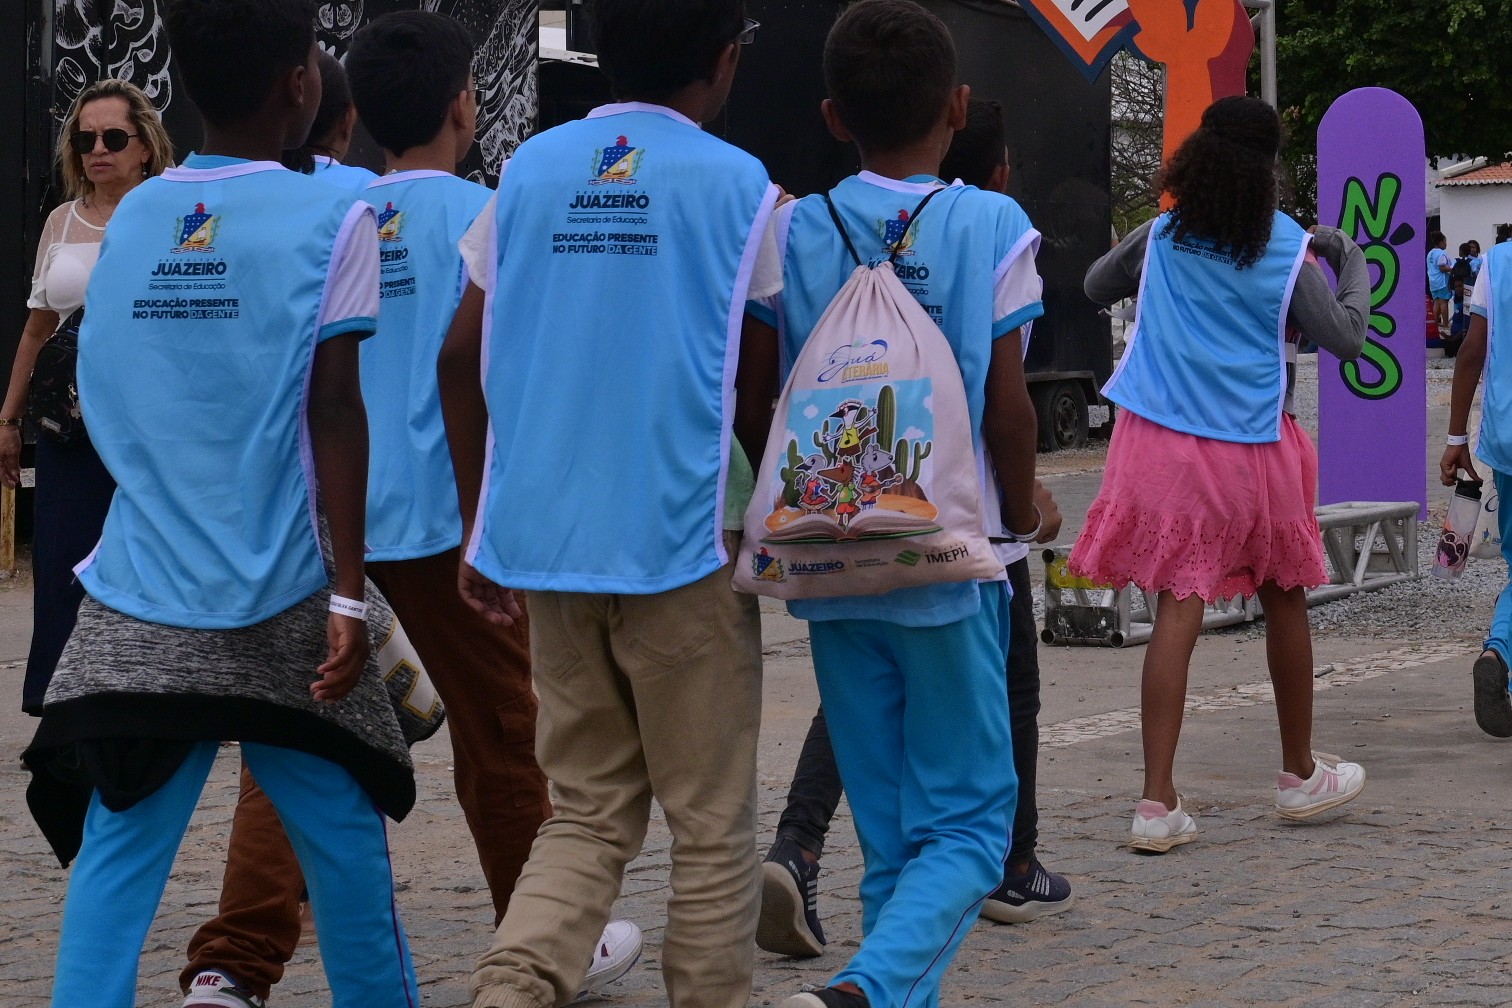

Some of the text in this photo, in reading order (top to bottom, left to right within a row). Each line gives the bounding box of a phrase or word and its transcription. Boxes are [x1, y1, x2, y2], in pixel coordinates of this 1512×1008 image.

[569, 194, 650, 209] JUAZEIRO
[566, 216, 647, 225] Secretaria de Educação
[553, 231, 658, 244] EDUCAÇÃO PRESENTE
[380, 248, 409, 262] ZEIRO
[553, 244, 657, 256] NO FUTURO DA GENTE
[151, 262, 227, 276] JUAZEIRO
[193, 282, 225, 291] Educação
[133, 297, 239, 310] EDUCAÇÃO PRESENTE
[132, 310, 239, 319] NO FUTURO DA GENTE
[788, 561, 844, 572] JUAZEIRO
[195, 975, 221, 986] NIKE
